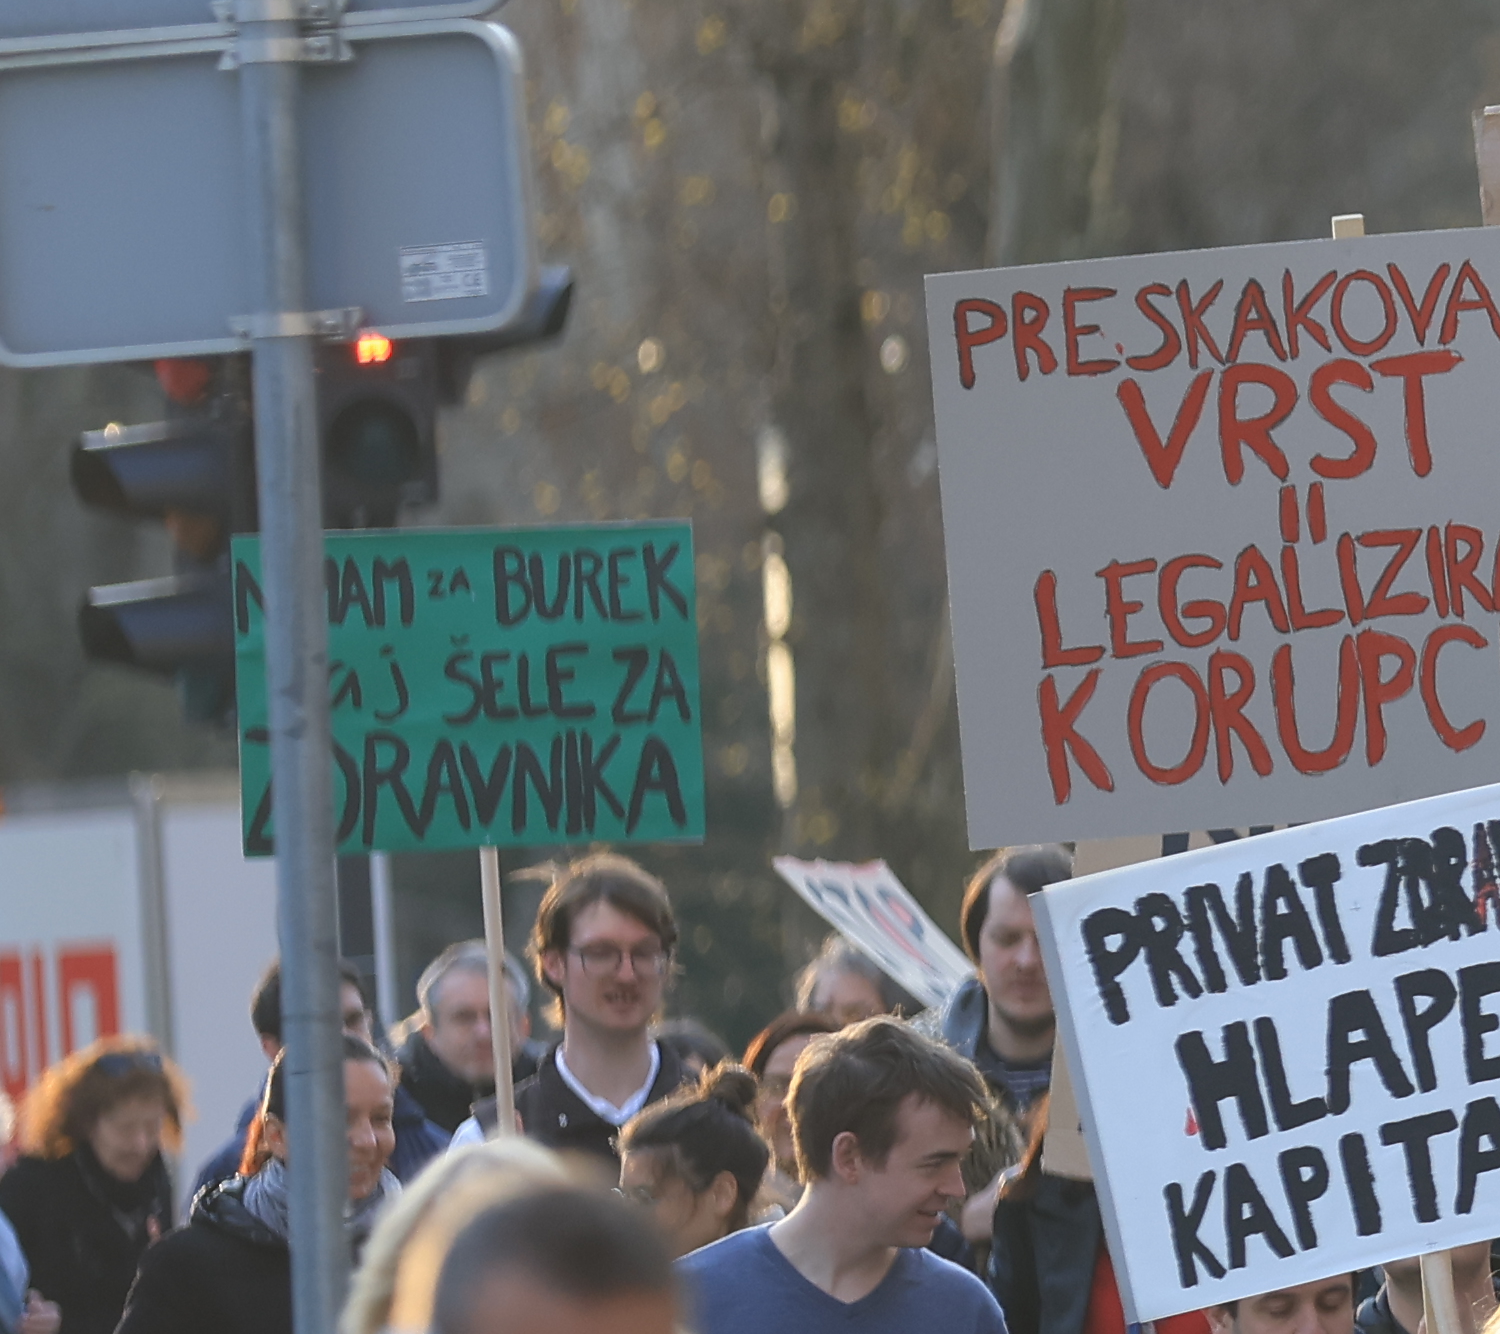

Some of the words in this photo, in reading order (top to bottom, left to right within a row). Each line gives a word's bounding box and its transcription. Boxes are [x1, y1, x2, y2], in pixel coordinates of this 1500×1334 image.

[1116, 350, 1465, 490] VRST
[494, 543, 690, 627] BUREK
[1081, 853, 1352, 1025] PRIVAT
